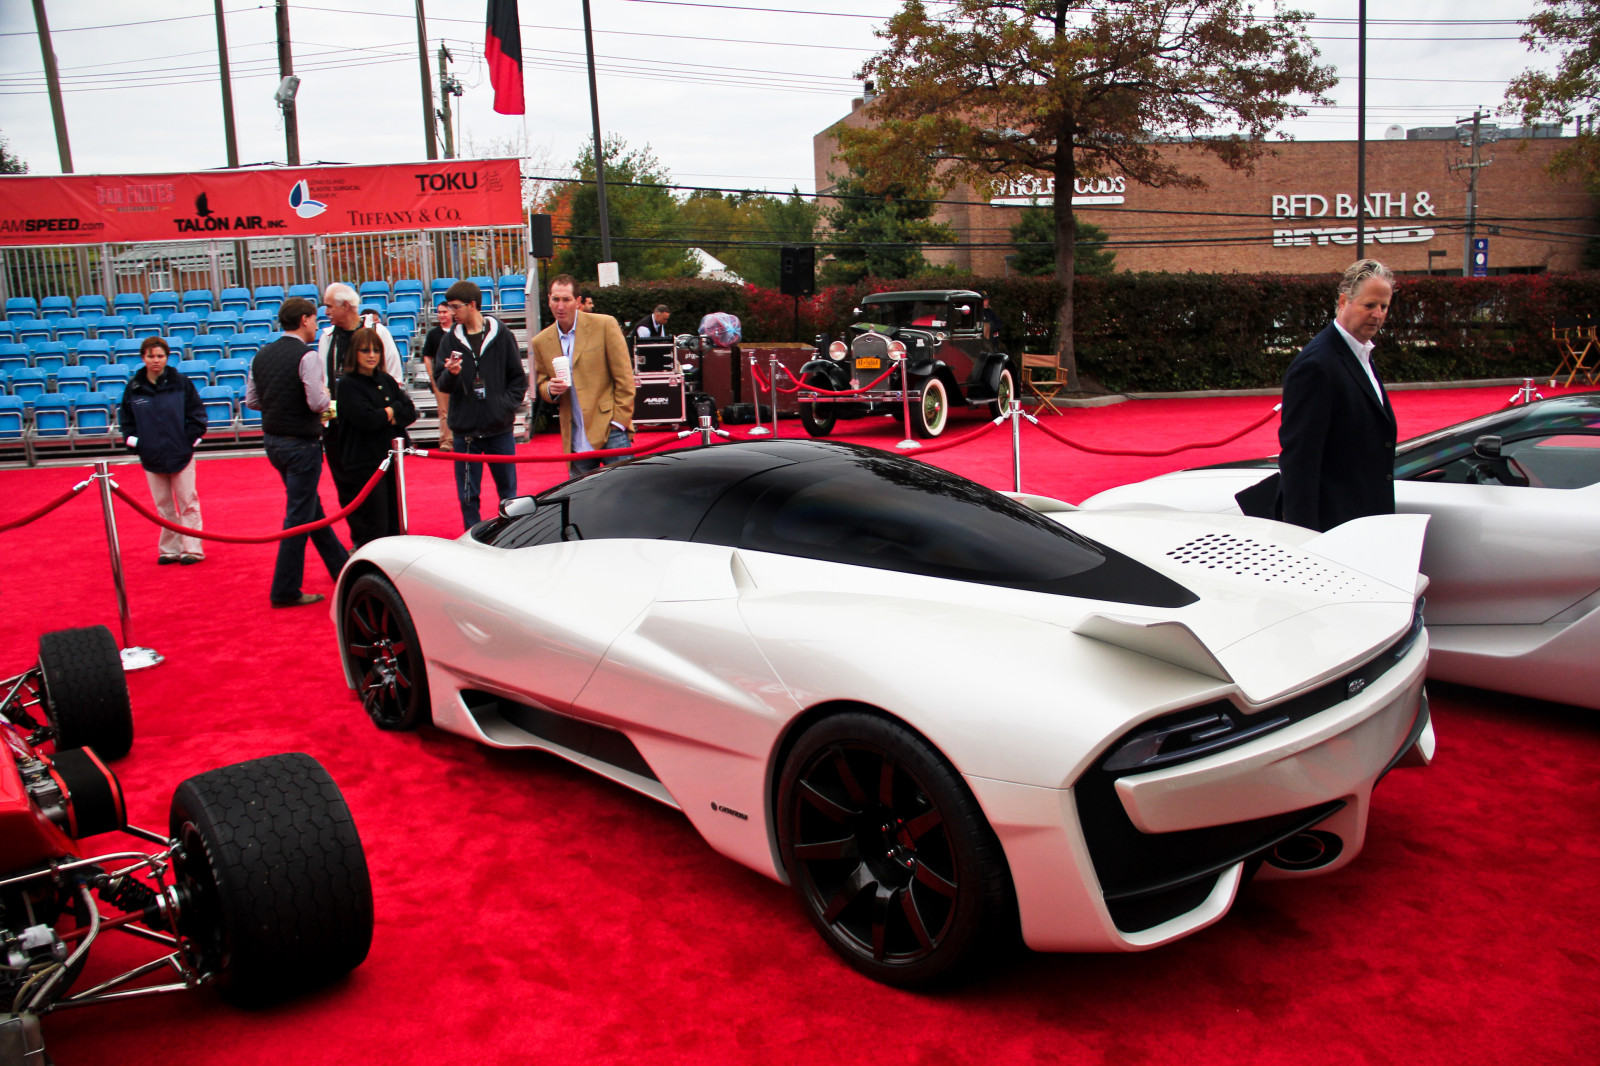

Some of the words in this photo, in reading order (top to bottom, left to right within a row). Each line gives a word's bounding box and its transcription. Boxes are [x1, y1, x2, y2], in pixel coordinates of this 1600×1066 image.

[414, 171, 478, 192] TOKU
[1073, 175, 1126, 194] OODS
[125, 183, 176, 204] FRITES
[1272, 193, 1329, 220] BED
[1335, 192, 1407, 218] BATH
[1412, 191, 1437, 217] &
[173, 217, 230, 232] TALON
[267, 219, 288, 229] INC.
[346, 209, 416, 226] TIFFANY
[418, 208, 431, 223] &
[1272, 225, 1436, 247] BEYOND
